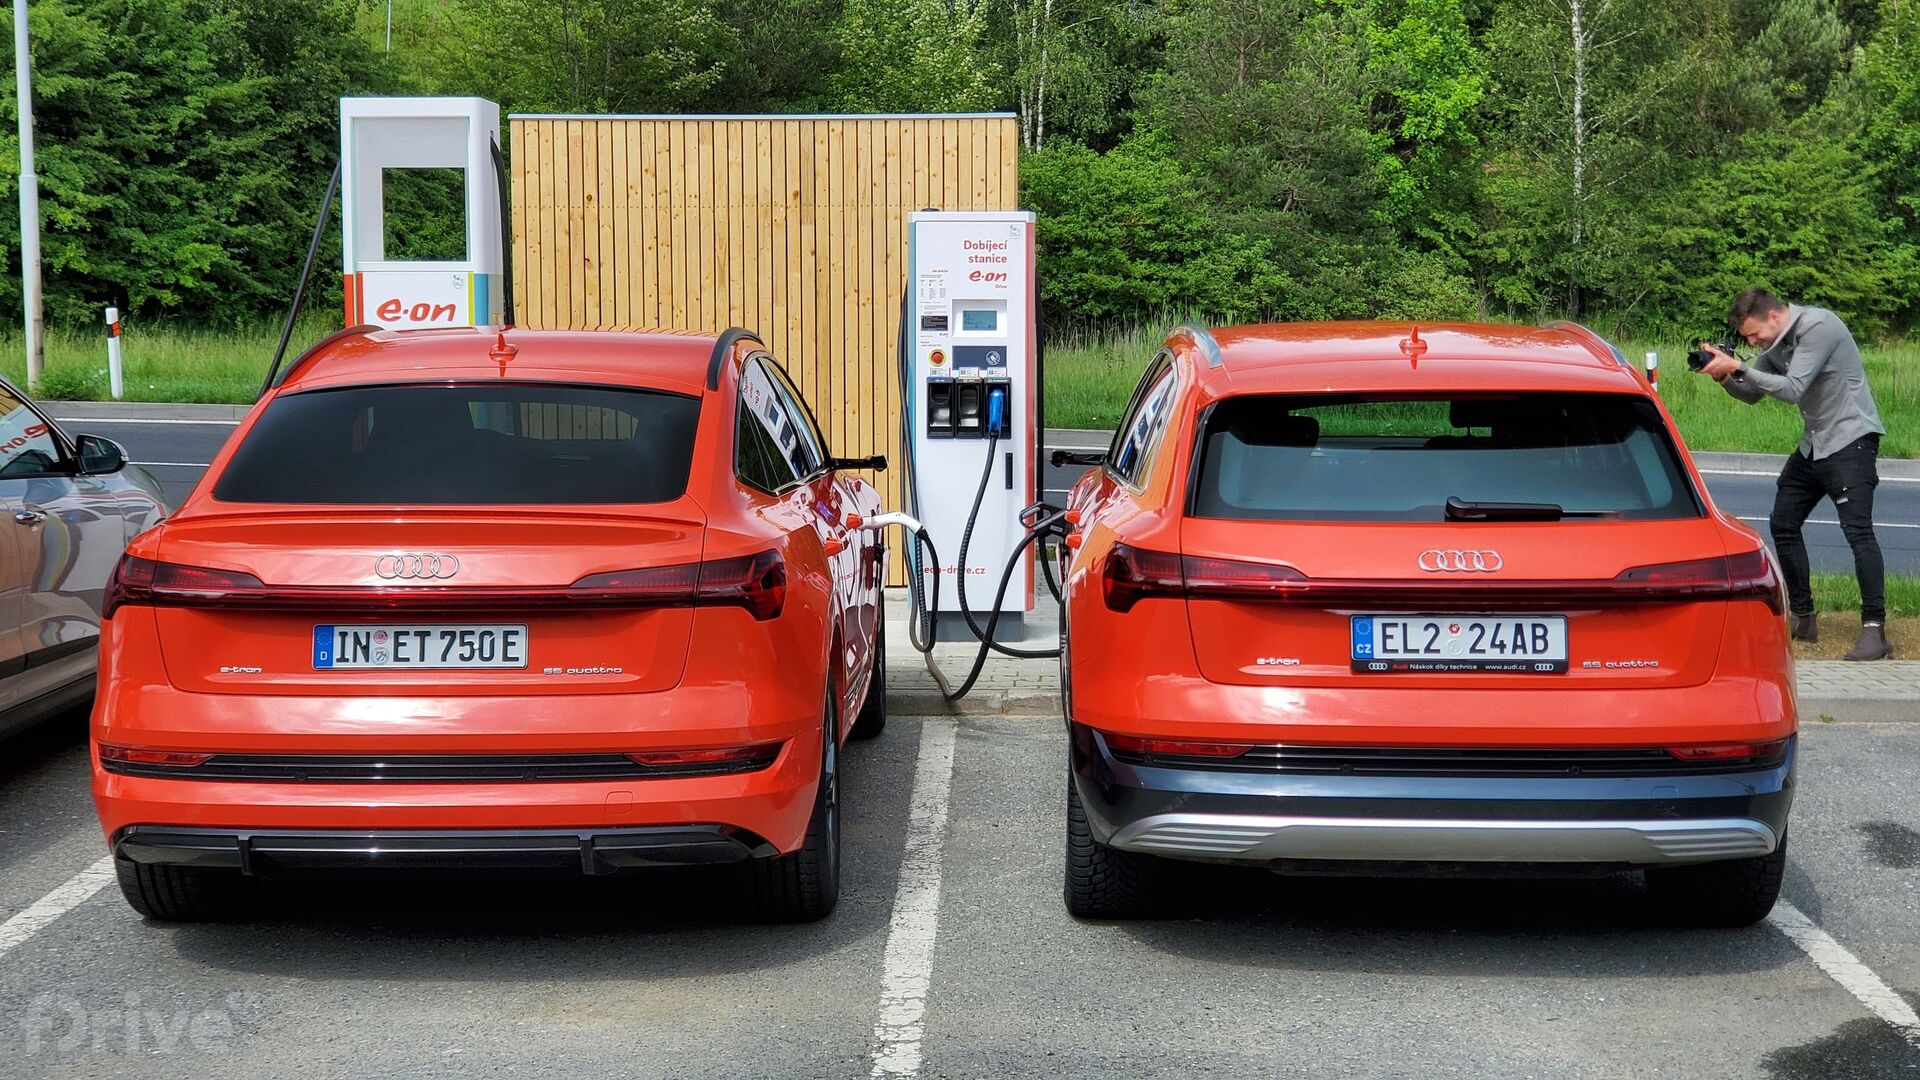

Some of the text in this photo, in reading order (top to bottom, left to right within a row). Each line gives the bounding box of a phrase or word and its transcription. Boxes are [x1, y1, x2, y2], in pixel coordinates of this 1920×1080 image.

[963, 240, 1008, 253] Dobíjecí
[968, 253, 1008, 264] stanice
[1381, 622, 1549, 655] EL2 24AB
[335, 631, 371, 663] IN
[393, 630, 431, 662] ET
[1356, 643, 1372, 654] CZ
[320, 651, 328, 661] D
[1256, 657, 1300, 666] e-tron
[1409, 662, 1433, 671] Náskok
[1449, 663, 1478, 671] technice
[1484, 663, 1527, 671] www.audi.cz
[1605, 660, 1659, 669] quattro
[220, 665, 263, 674] e-tron
[566, 667, 623, 675] quattro
